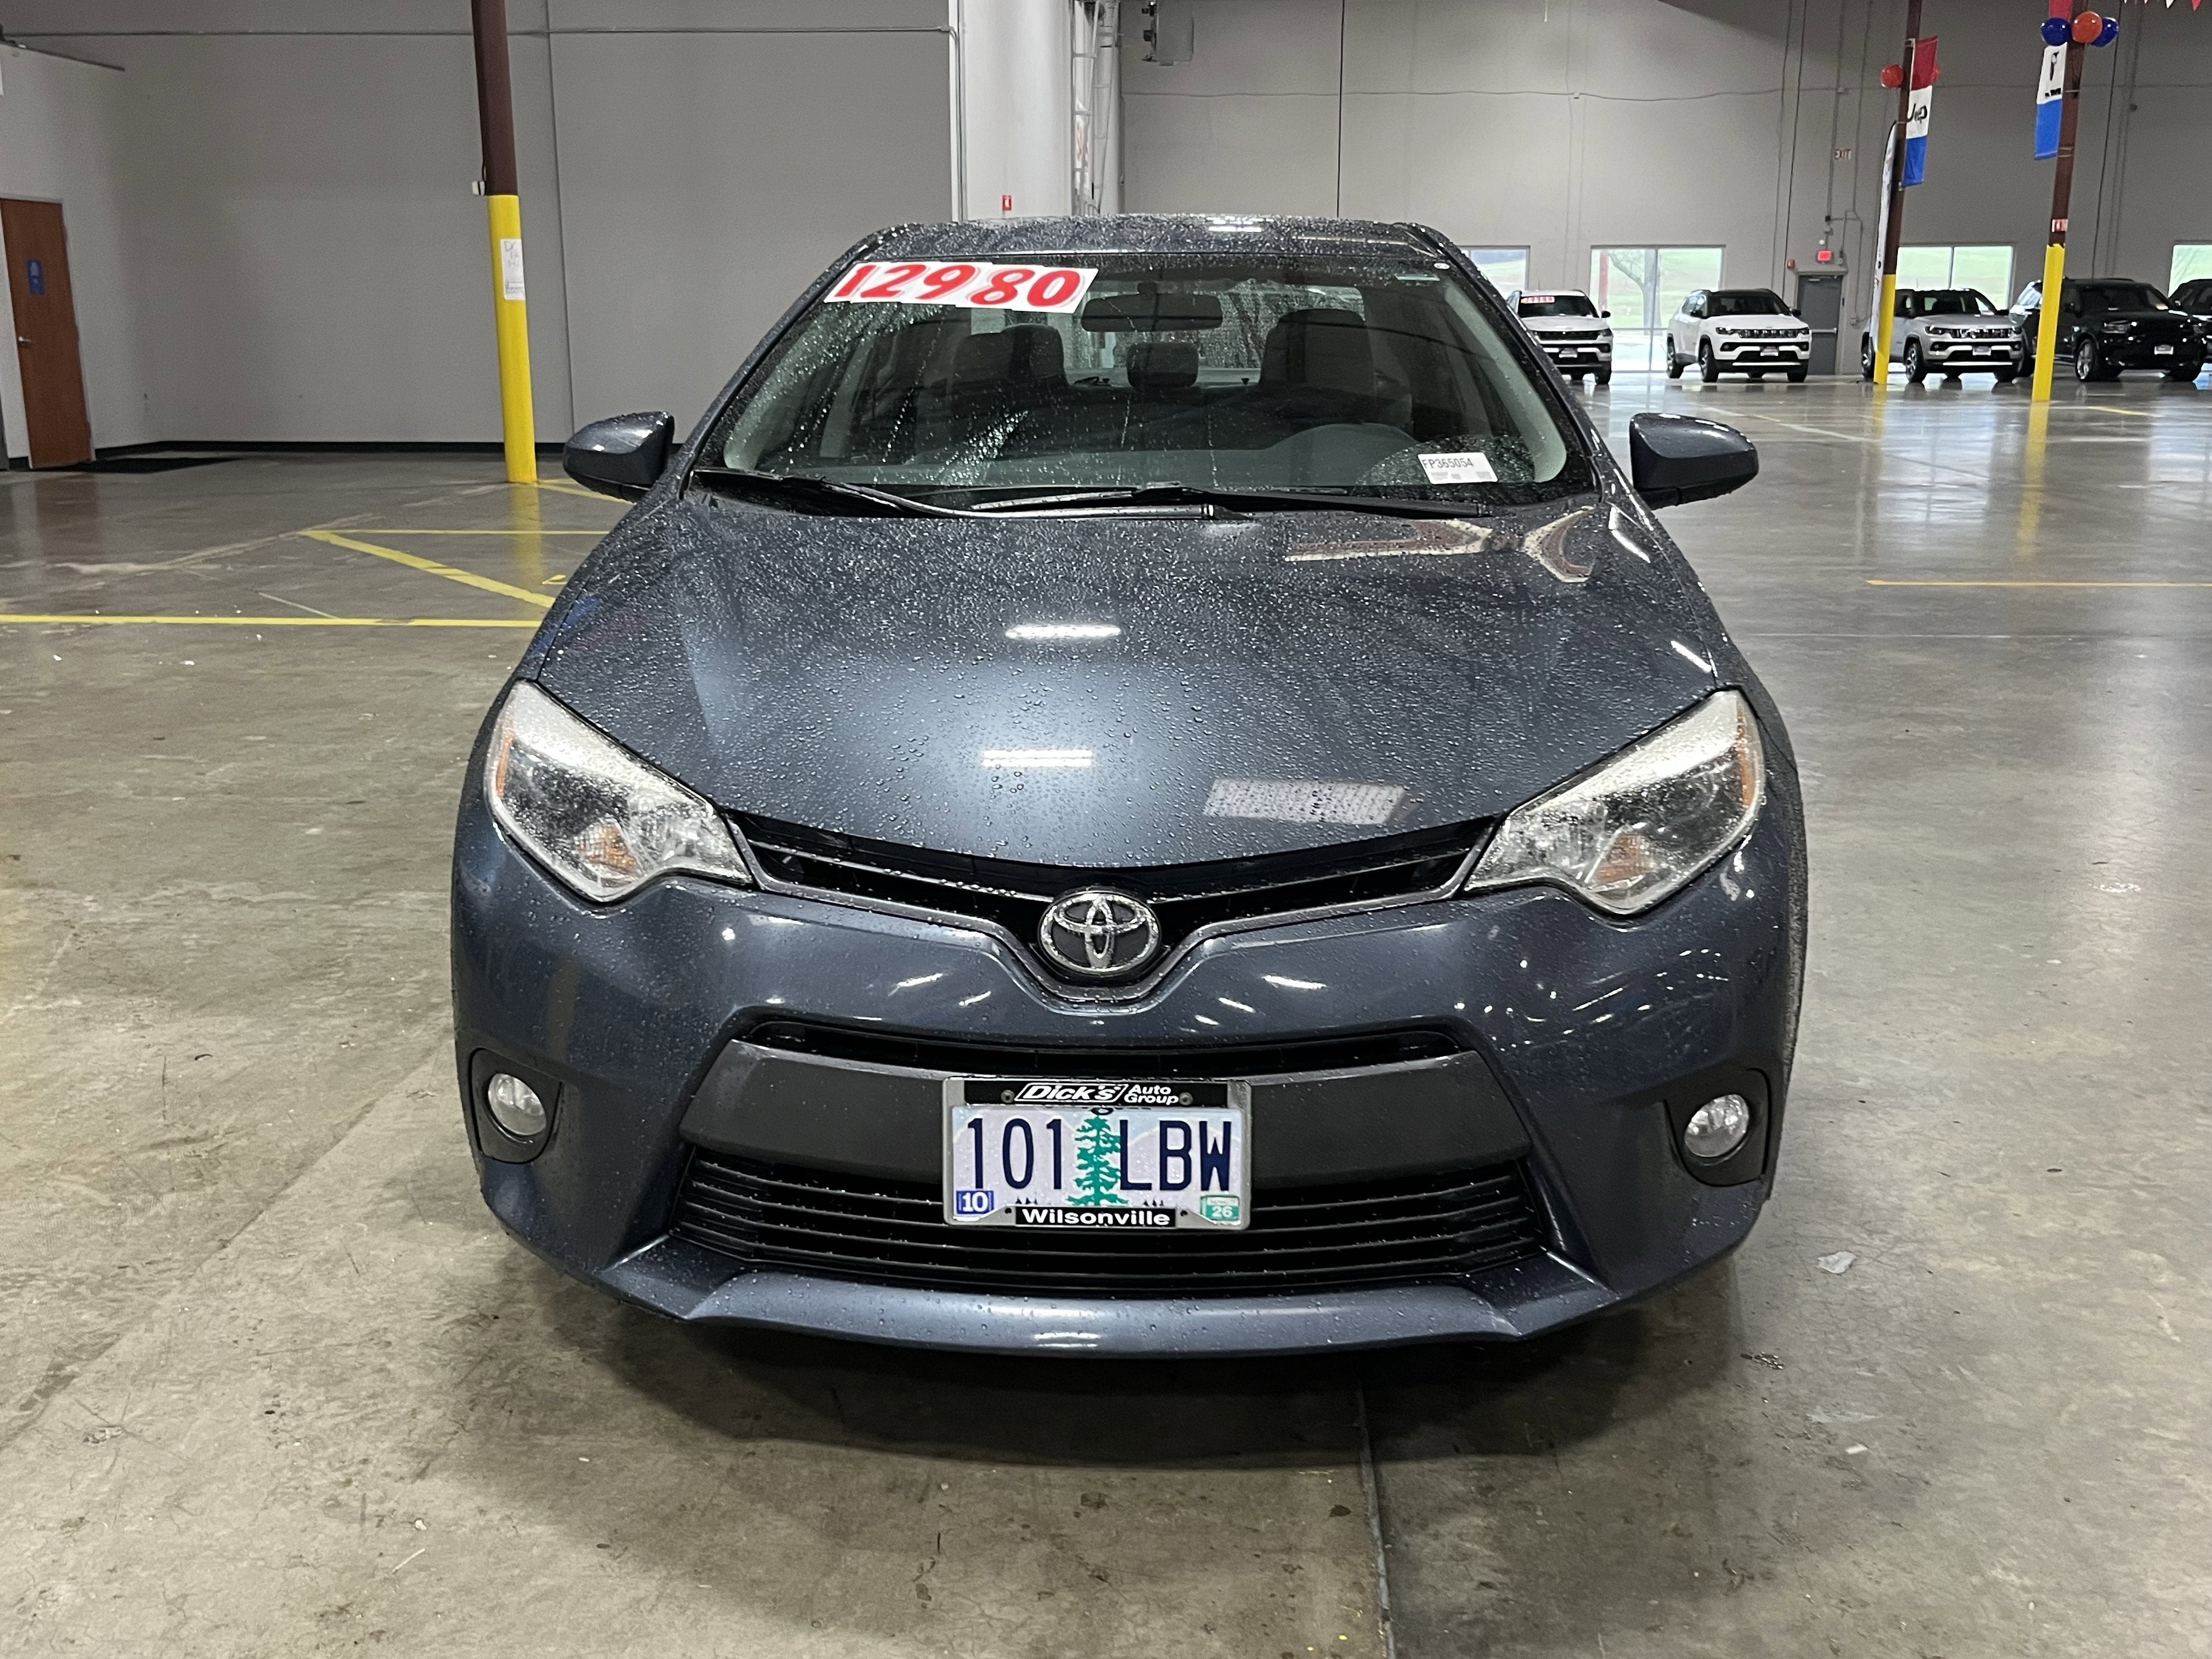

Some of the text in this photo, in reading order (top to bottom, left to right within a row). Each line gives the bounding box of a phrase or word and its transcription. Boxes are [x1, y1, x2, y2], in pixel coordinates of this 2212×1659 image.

[834, 264, 1082, 307] 12980
[1128, 1084, 1172, 1094] Auto
[1124, 1093, 1180, 1105] Group
[967, 1118, 1232, 1192] 101 LBW
[962, 1192, 988, 1212] 10
[1022, 1209, 1170, 1225] Wilsonville
[1211, 1206, 1233, 1218] 26
